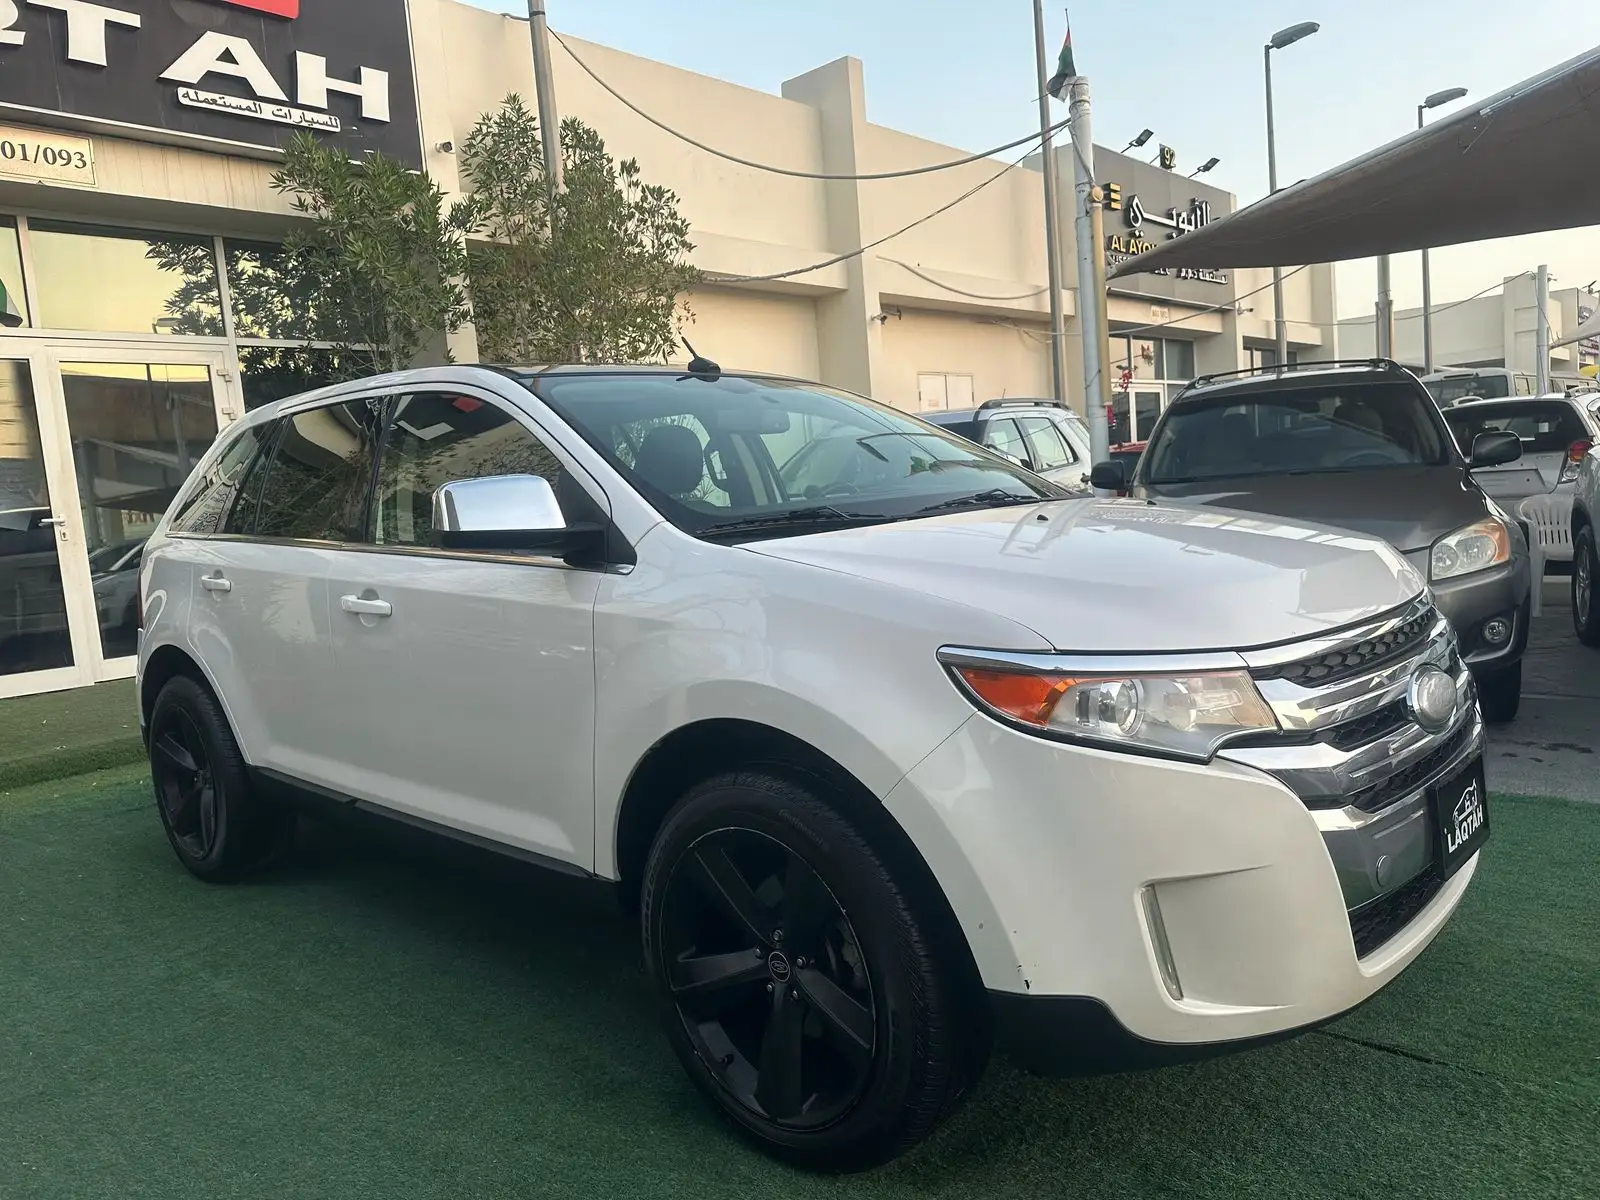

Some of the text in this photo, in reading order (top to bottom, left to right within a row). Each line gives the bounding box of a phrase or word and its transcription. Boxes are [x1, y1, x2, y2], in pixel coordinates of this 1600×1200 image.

[272, 108, 340, 130] للسيارات
[1, 140, 87, 169] 01/093
[1111, 235, 1126, 252] AL
[1447, 804, 1484, 854] LAQTAH
